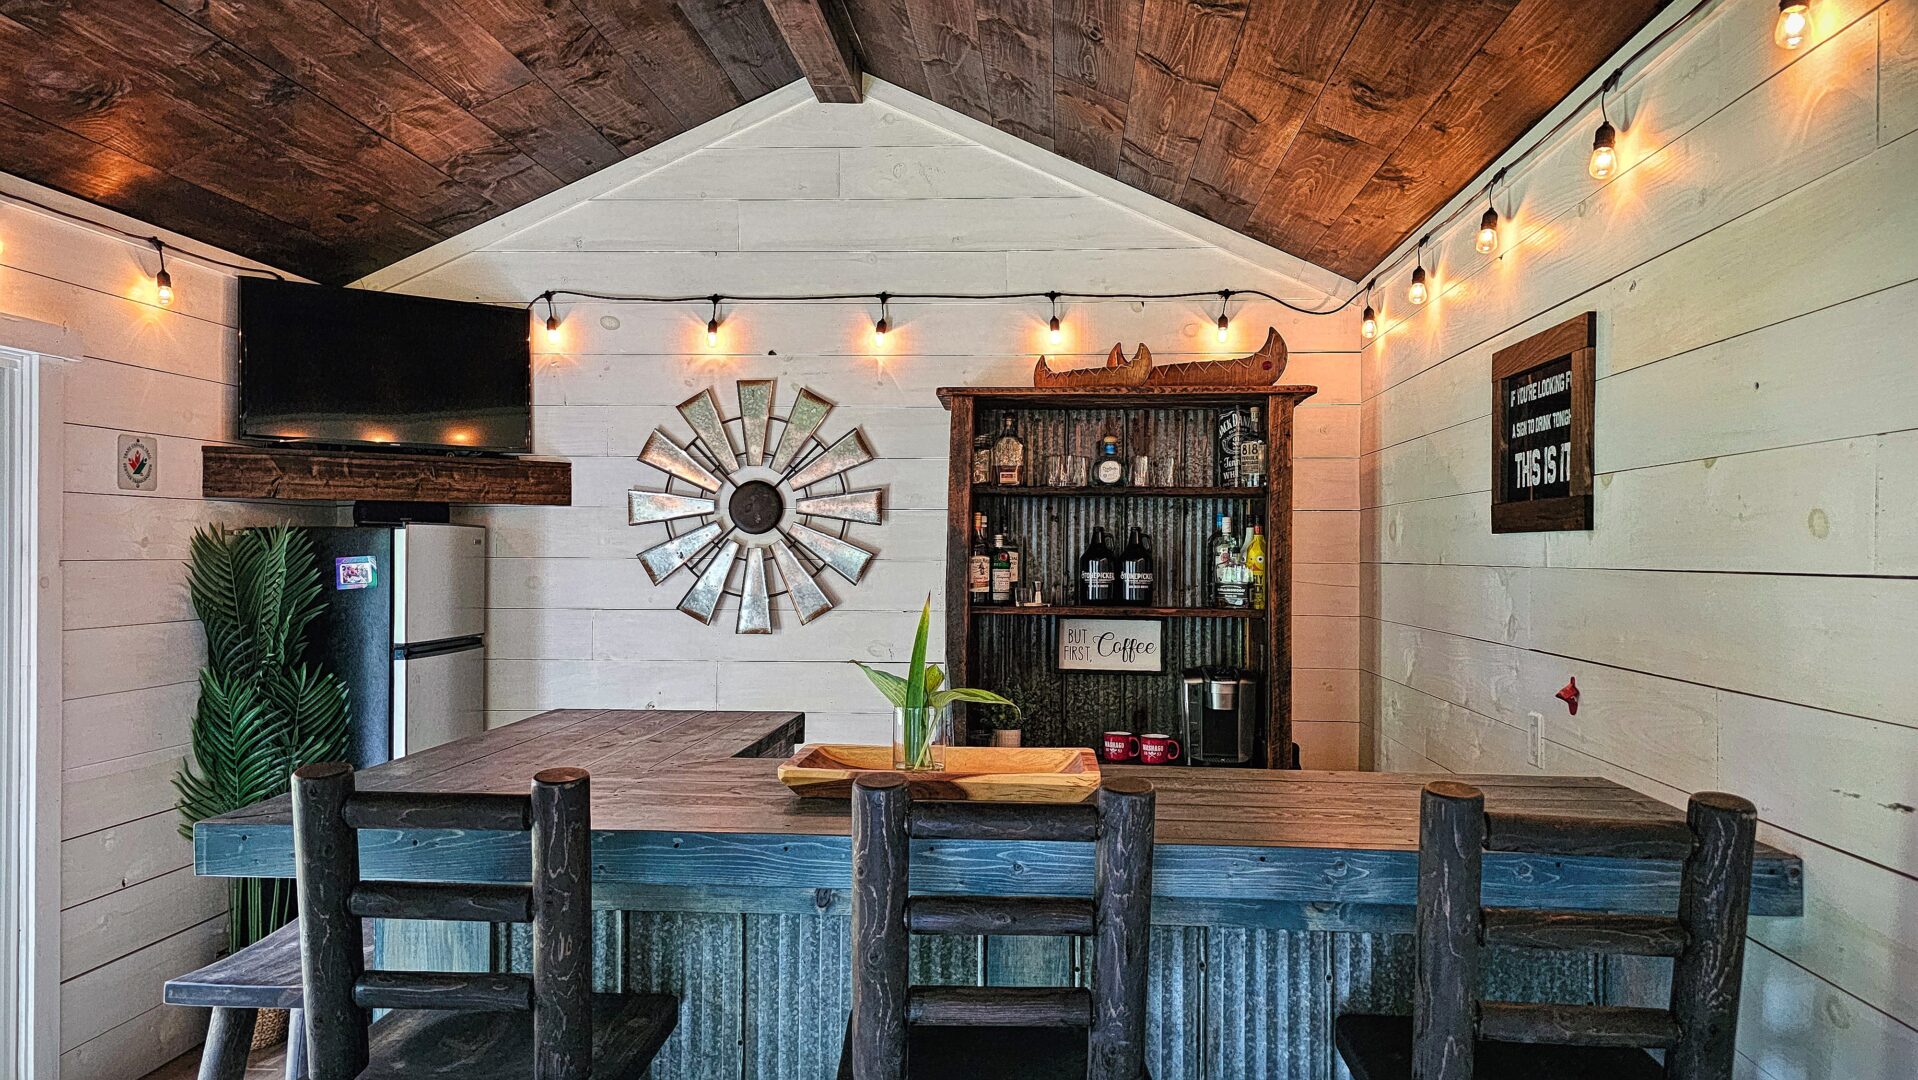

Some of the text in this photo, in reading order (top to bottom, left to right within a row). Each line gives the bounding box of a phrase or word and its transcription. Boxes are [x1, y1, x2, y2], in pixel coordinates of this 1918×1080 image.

[1511, 389, 1516, 408] F
[1538, 373, 1565, 399] LOOKING
[1219, 418, 1233, 439] JACK
[1512, 423, 1516, 439] A
[1516, 420, 1528, 438] SIGN
[1528, 418, 1535, 434] TO
[1535, 413, 1552, 433] DRINK
[1242, 443, 1259, 455] 818
[1514, 448, 1541, 489] THIS
[1543, 445, 1557, 485] IS
[1063, 631, 1158, 664] FIRST, Coffee
[1068, 628, 1088, 644] BUT
